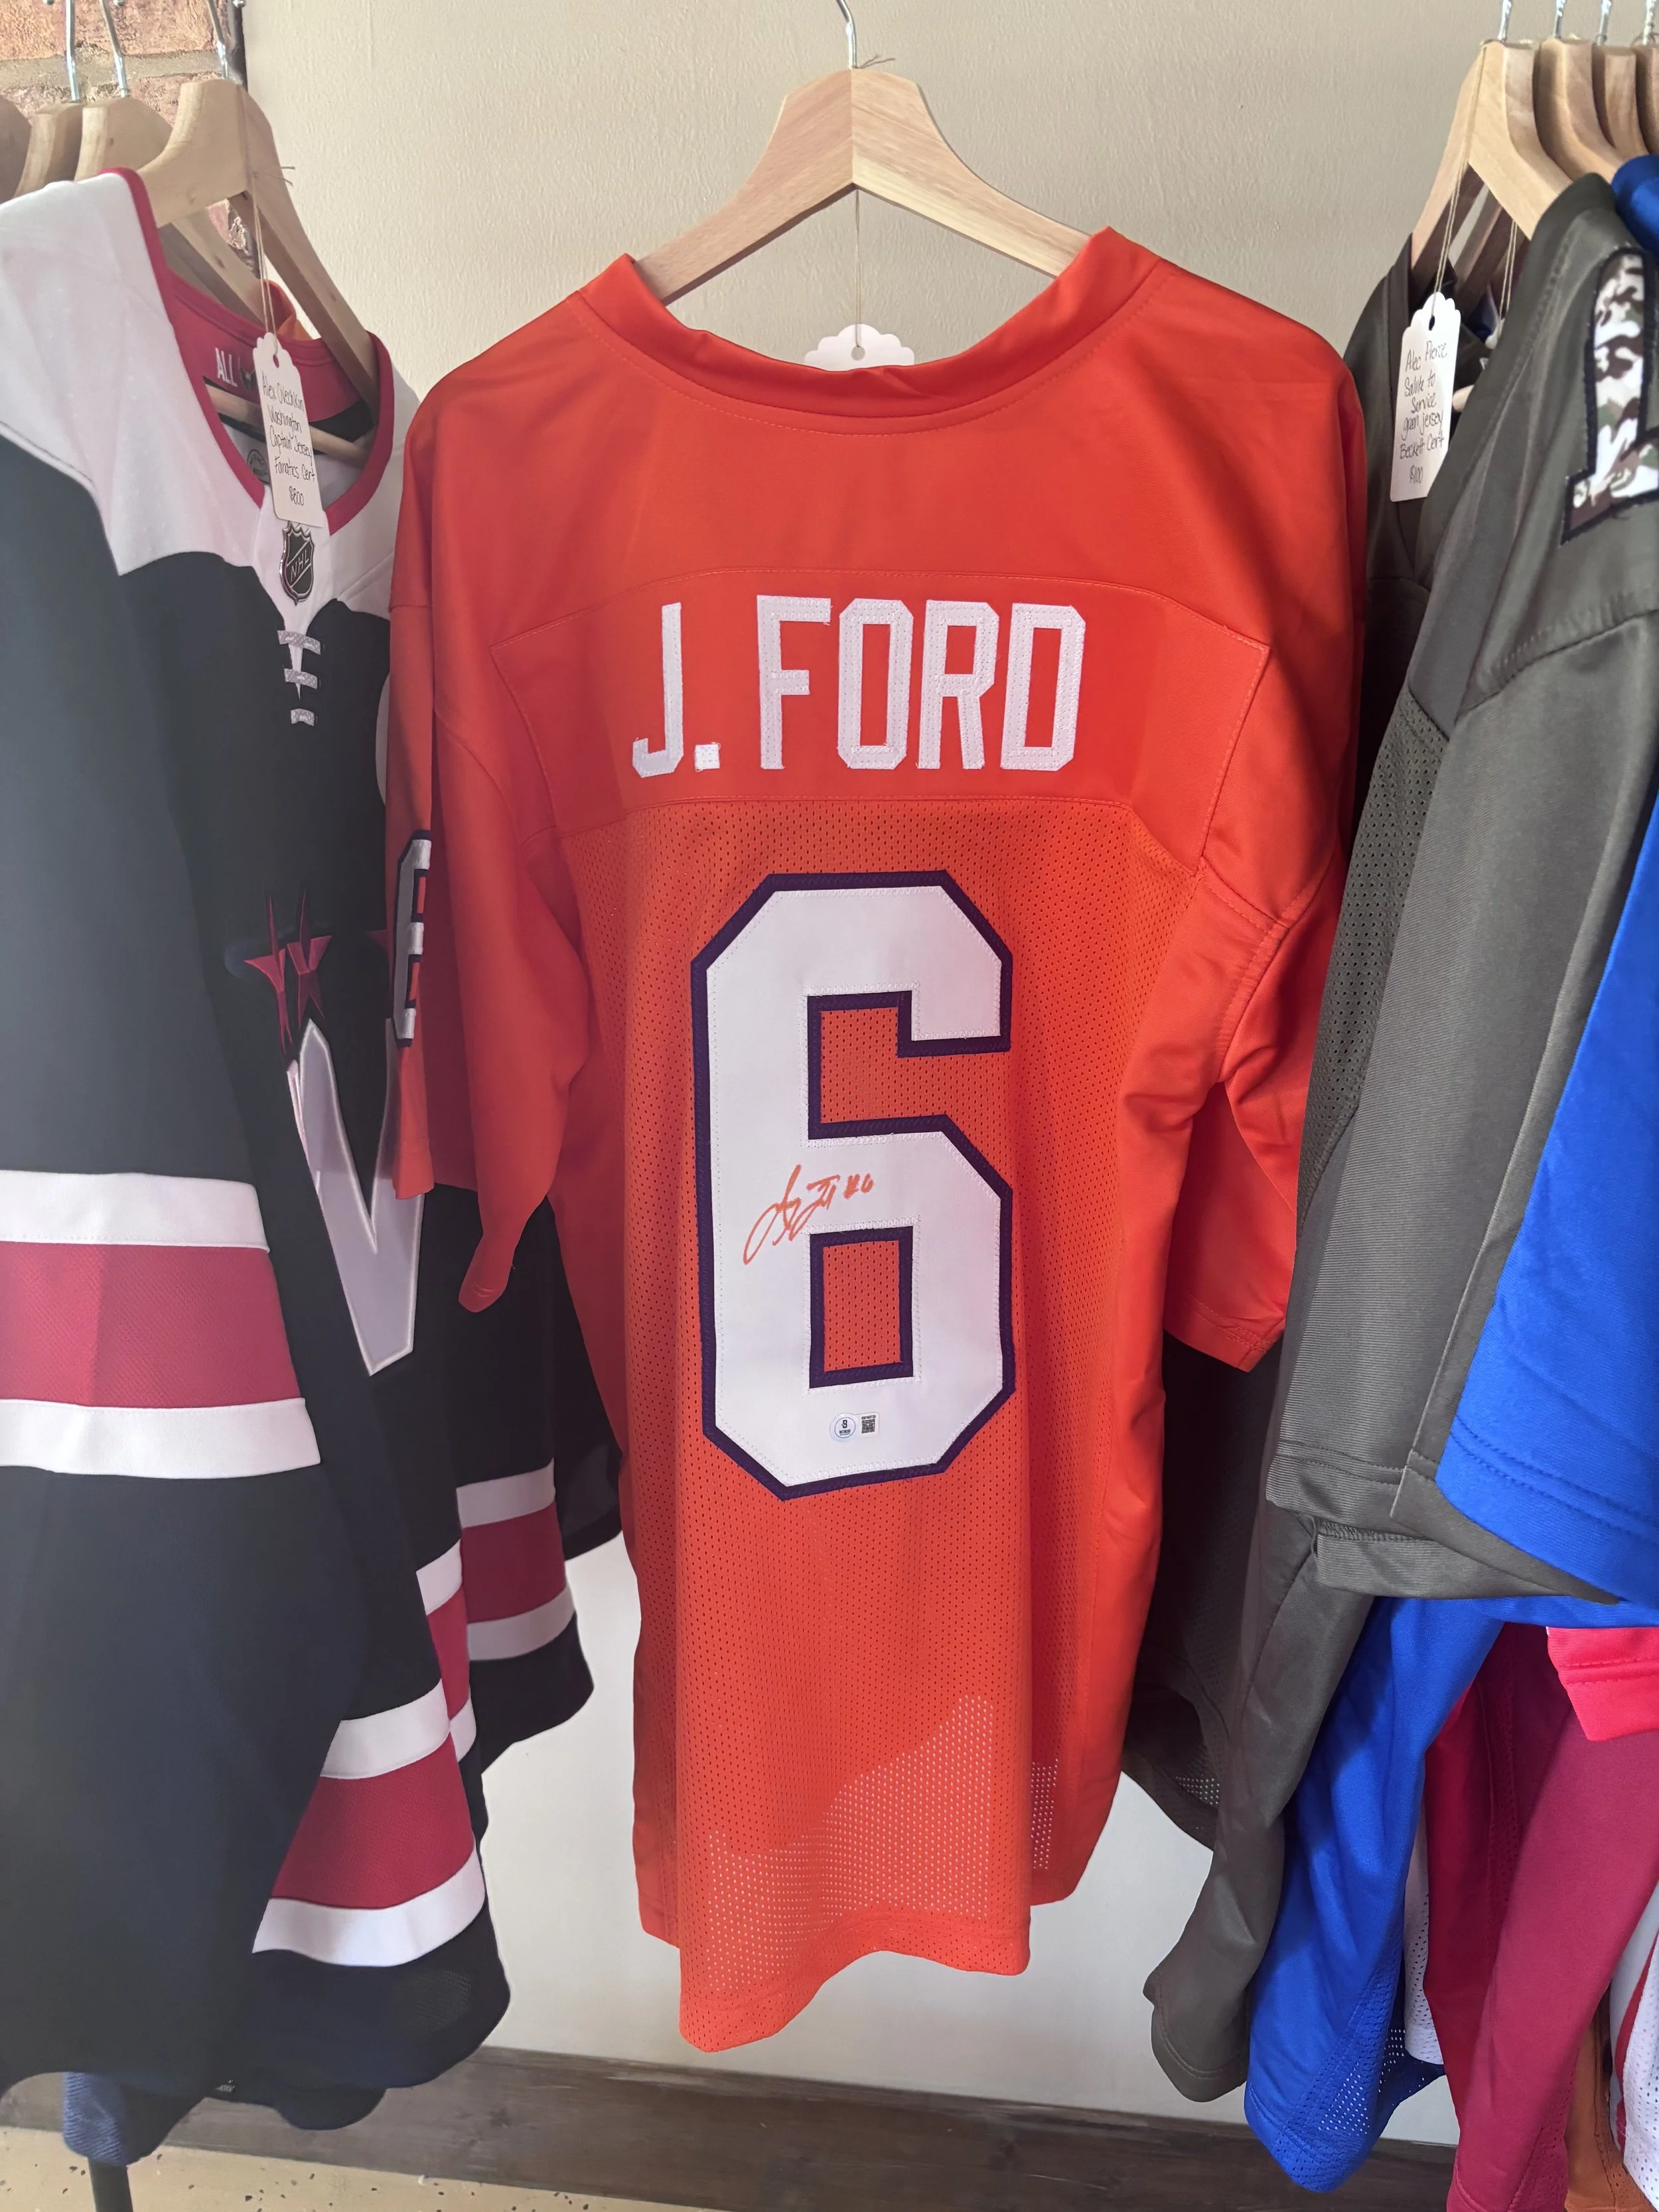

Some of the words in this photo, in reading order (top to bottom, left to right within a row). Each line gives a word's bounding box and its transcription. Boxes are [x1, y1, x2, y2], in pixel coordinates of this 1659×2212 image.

[215, 347, 238, 388] ALL
[1405, 349, 1421, 372] Alec
[262, 371, 276, 402] Alex
[1404, 375, 1424, 397] Salute
[1428, 369, 1436, 388] to
[267, 405, 302, 439] Washington
[270, 425, 293, 454] Captain
[275, 457, 299, 479] Fanatics
[289, 486, 305, 506] $800
[290, 550, 309, 583] NHL
[632, 602, 721, 778] J.
[757, 595, 1086, 771] FORD
[691, 870, 1016, 1501] 6
